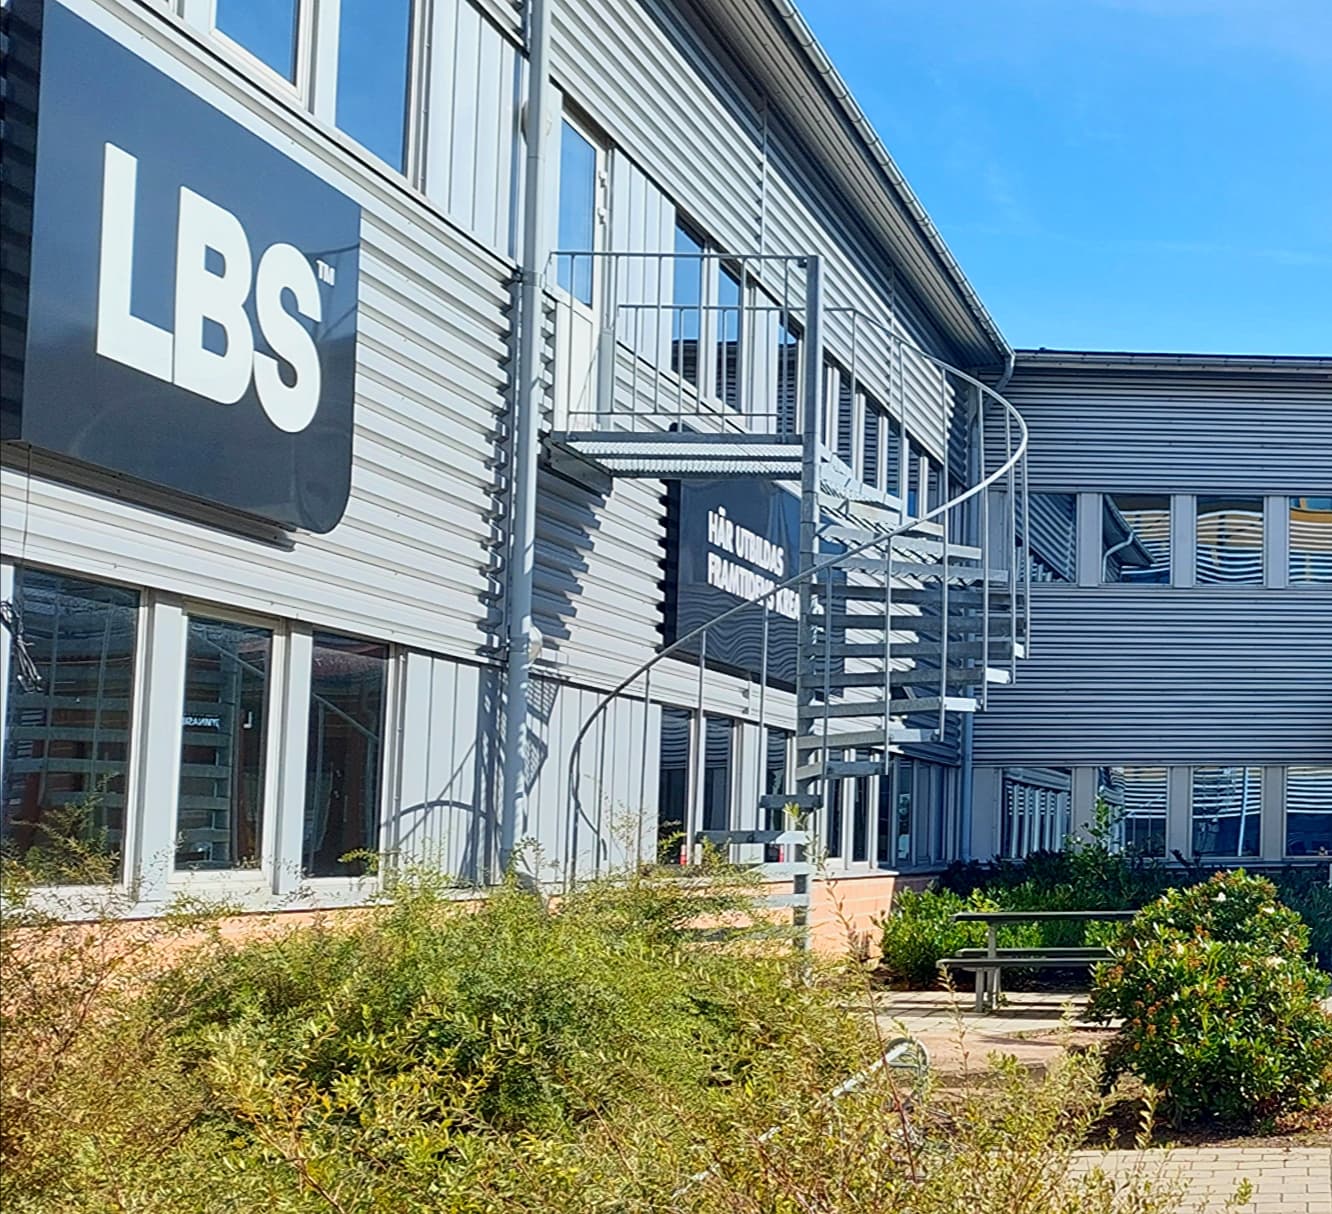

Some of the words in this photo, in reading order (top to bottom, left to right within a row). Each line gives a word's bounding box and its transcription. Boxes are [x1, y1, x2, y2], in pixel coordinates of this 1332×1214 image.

[97, 142, 321, 433] LBS
[708, 506, 734, 554] HÄR
[735, 525, 784, 577] UTBILDAS
